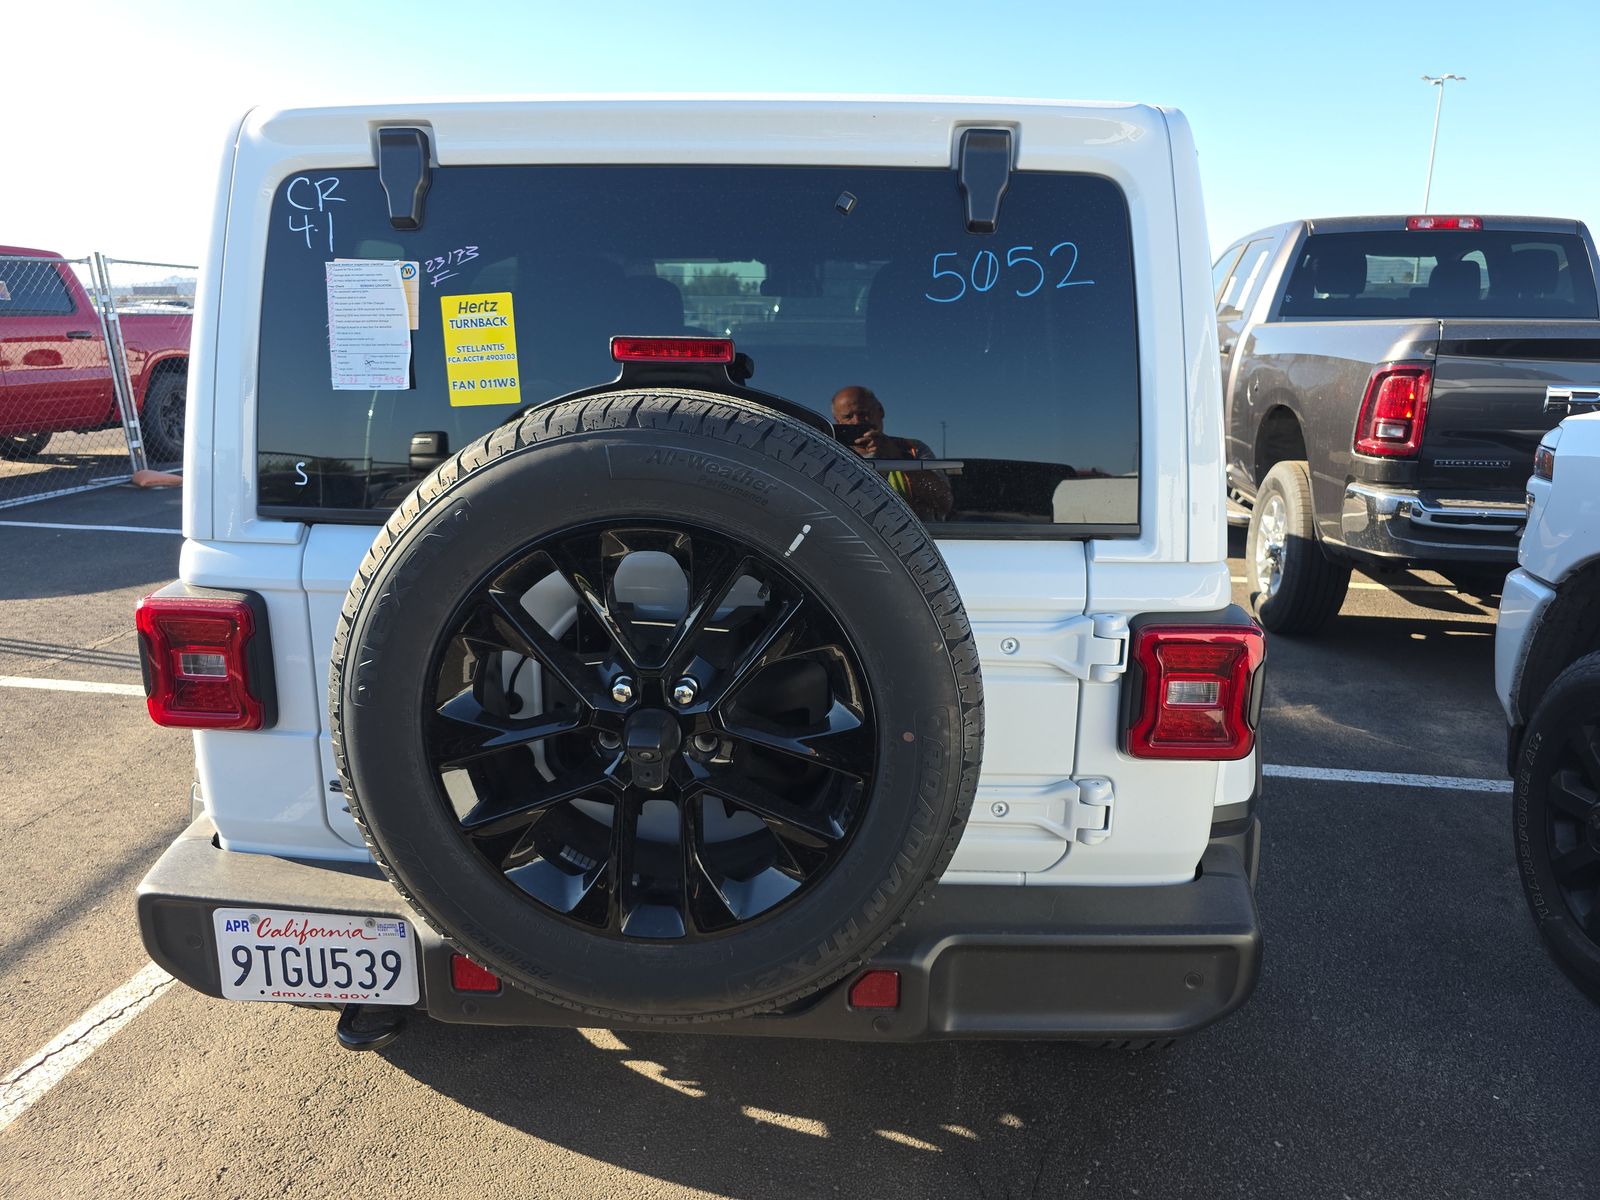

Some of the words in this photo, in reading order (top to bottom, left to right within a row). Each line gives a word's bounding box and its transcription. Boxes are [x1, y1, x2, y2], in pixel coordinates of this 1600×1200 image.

[286, 176, 347, 212] CR
[925, 241, 1095, 303] 5052
[458, 300, 499, 314] Hertz
[449, 316, 508, 329] TURNBACK
[456, 343, 505, 353] STELLANTIS
[486, 353, 516, 361] 4903103
[452, 380, 476, 390] FAN
[480, 377, 517, 389] 011W8
[646, 449, 779, 495] All-Weather
[700, 476, 769, 506] Performance
[225, 919, 250, 932] APR
[256, 917, 377, 945] California
[231, 945, 402, 991] 9TGU539
[271, 990, 371, 1000] dmv.ca.gov
